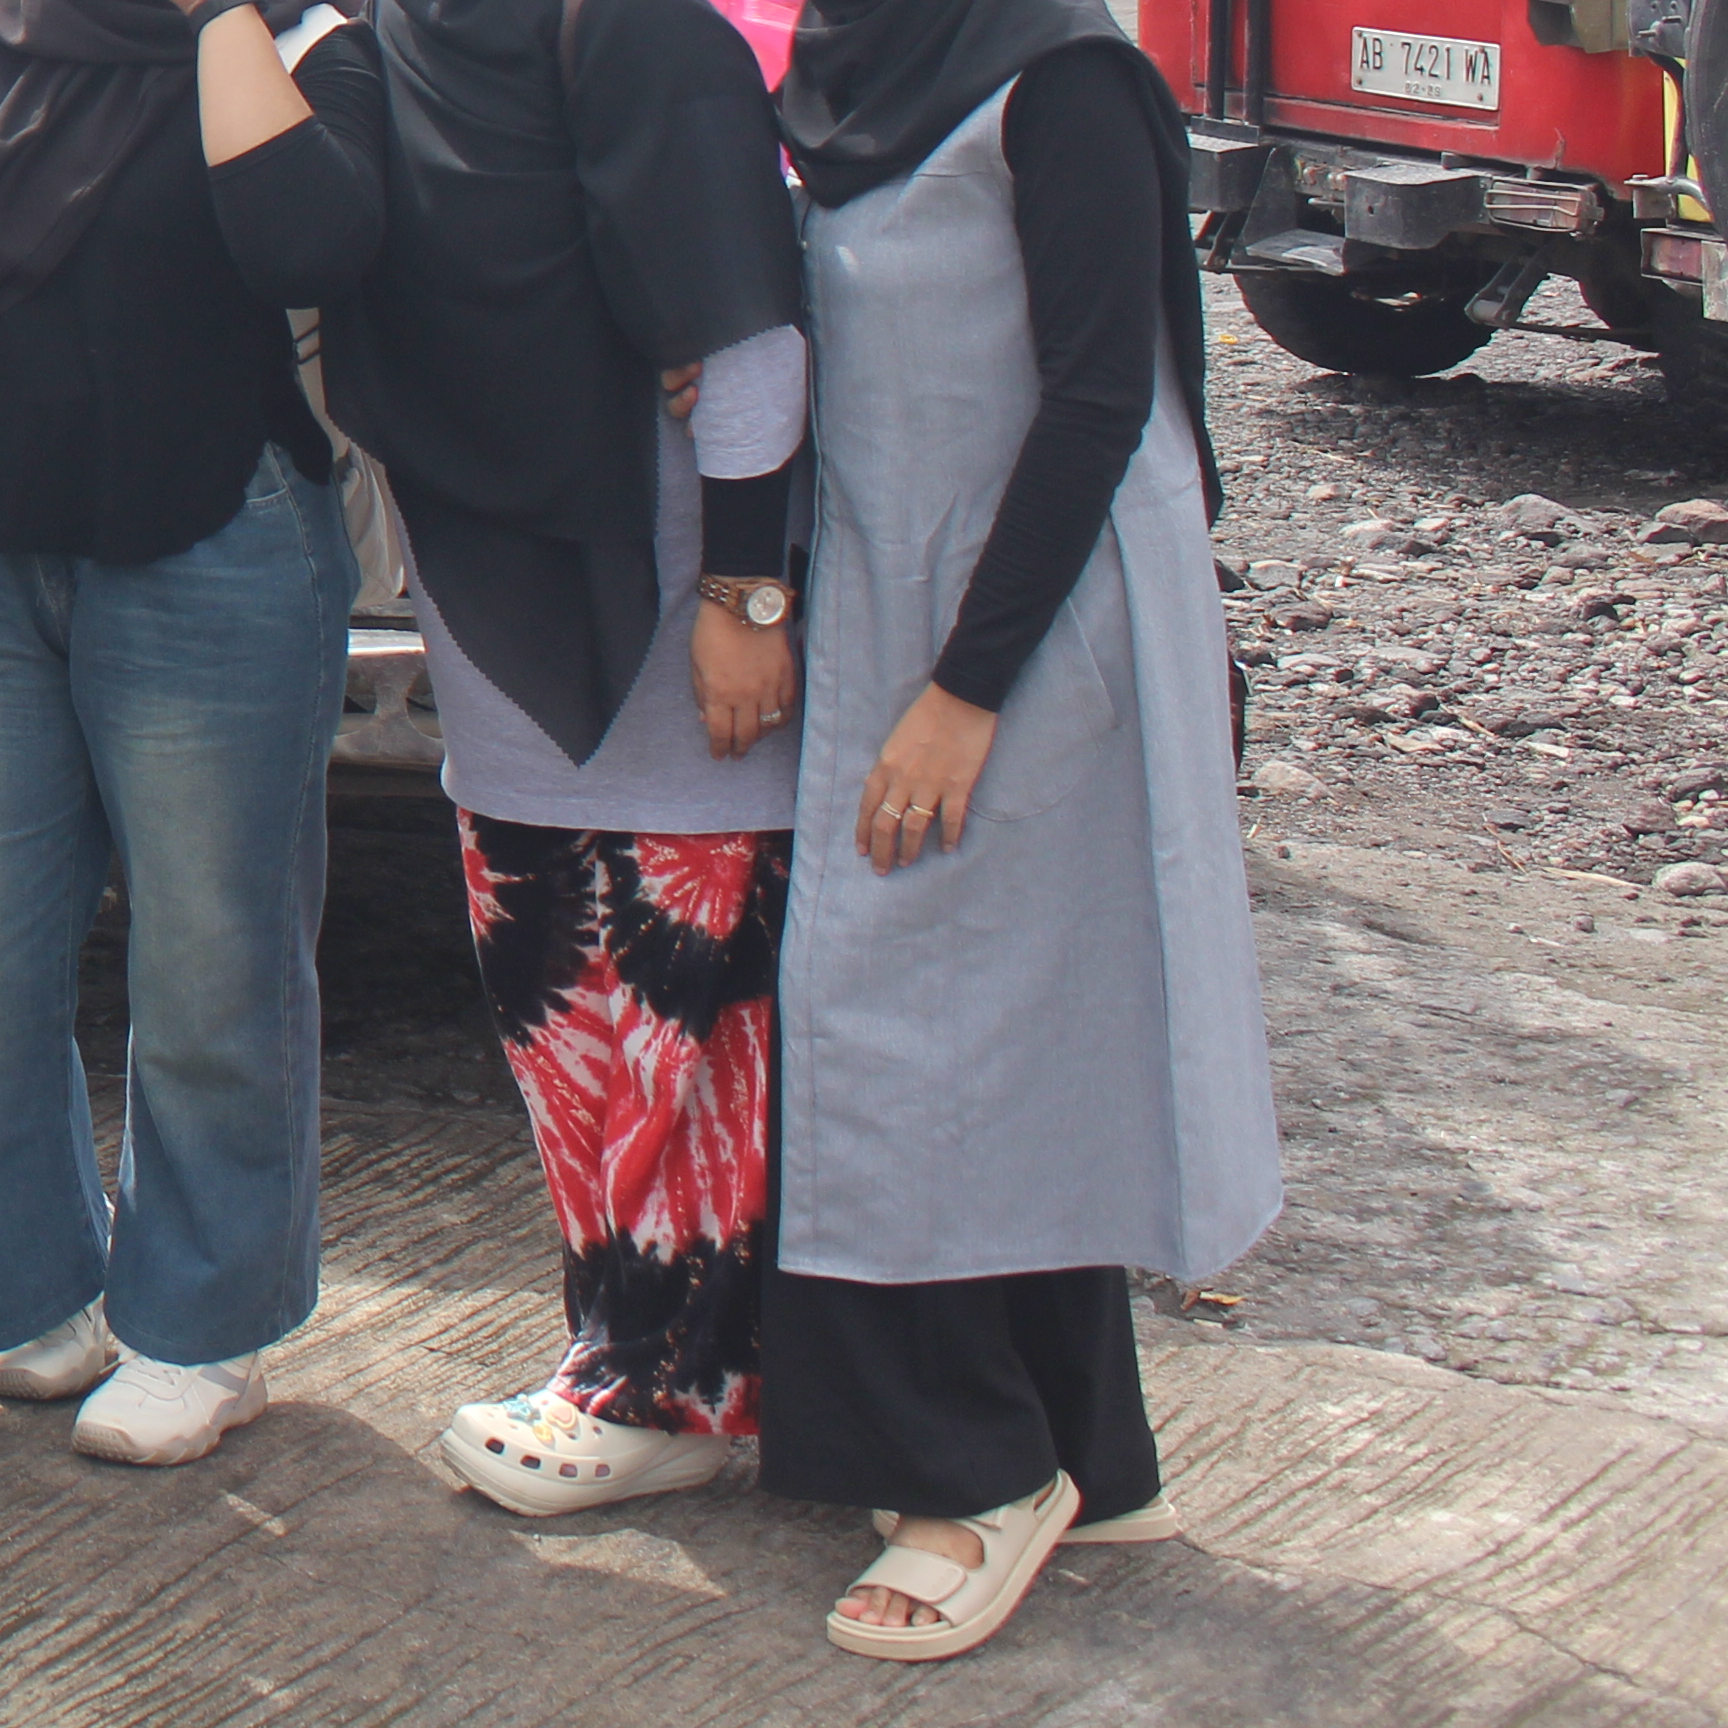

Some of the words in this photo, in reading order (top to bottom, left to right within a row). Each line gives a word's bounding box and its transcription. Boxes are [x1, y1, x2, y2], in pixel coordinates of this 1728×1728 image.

[1360, 37, 1384, 71] AB
[1401, 42, 1451, 80] 7421
[1465, 48, 1491, 87] WA
